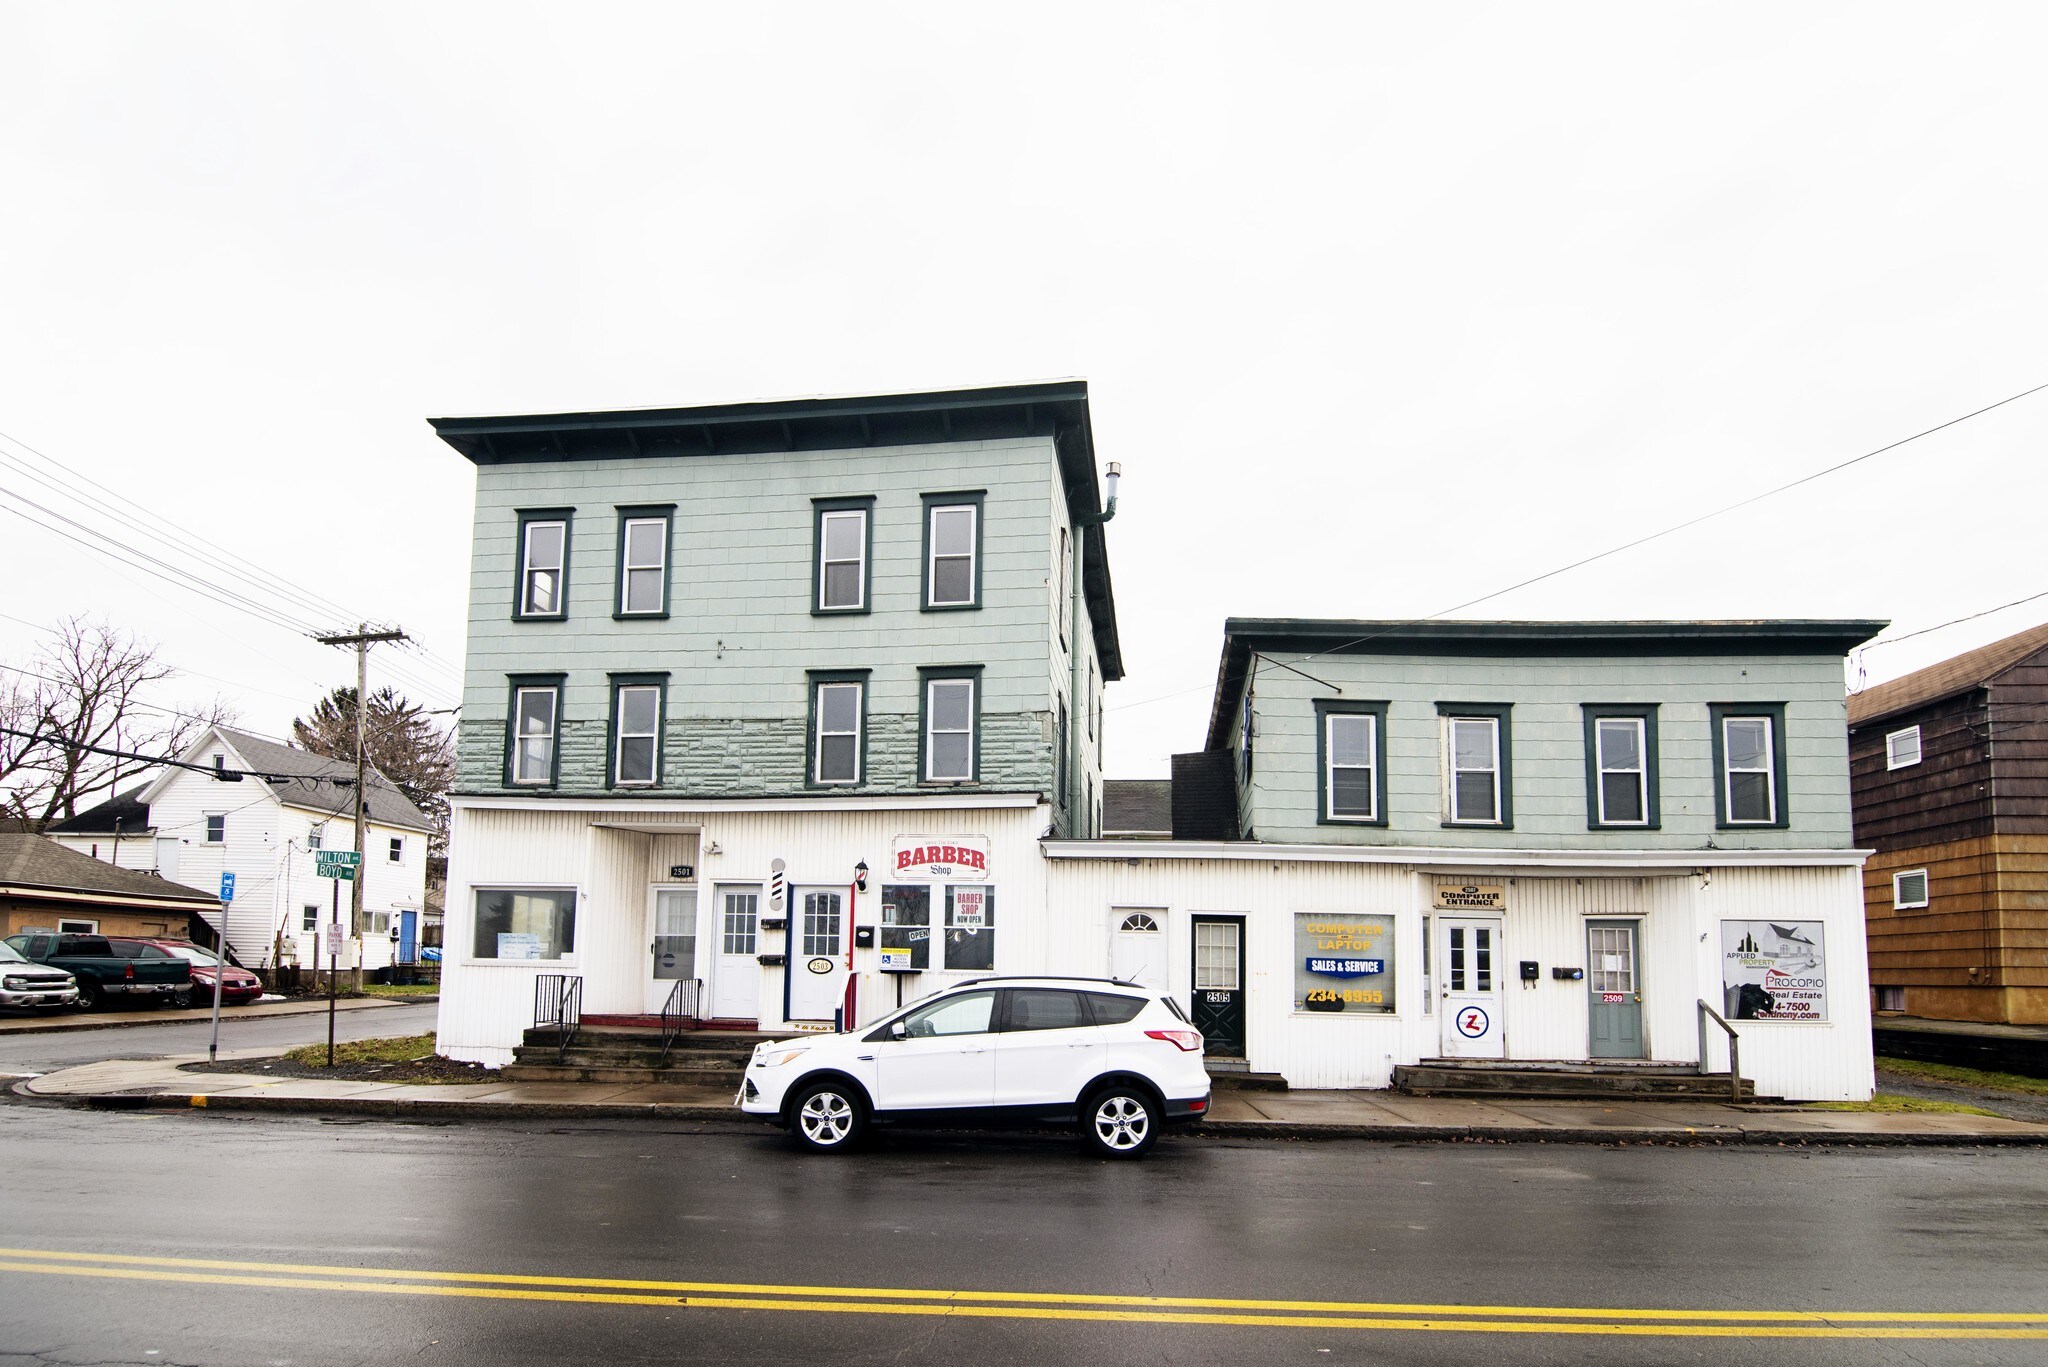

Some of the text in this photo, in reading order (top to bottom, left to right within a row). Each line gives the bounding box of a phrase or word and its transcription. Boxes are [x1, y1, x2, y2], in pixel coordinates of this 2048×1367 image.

[316, 852, 350, 863] MILTON
[897, 846, 985, 870] BARBER
[320, 865, 342, 878] BOYD
[930, 865, 952, 876] Shop
[957, 893, 983, 904] BARBER
[961, 904, 979, 914] SHOP
[911, 929, 928, 939] OPEN
[1307, 923, 1383, 935] COMPUTER
[1318, 940, 1372, 950] LAPTOP
[812, 962, 829, 971] 2503
[1312, 960, 1379, 973] SALES & SERVICE
[1766, 977, 1824, 987] PROCOPIO
[1208, 992, 1228, 1001] 2505
[1603, 994, 1622, 1002] 2509
[1770, 991, 1823, 999] Real Estate
[1774, 1002, 1810, 1011] 4-7500
